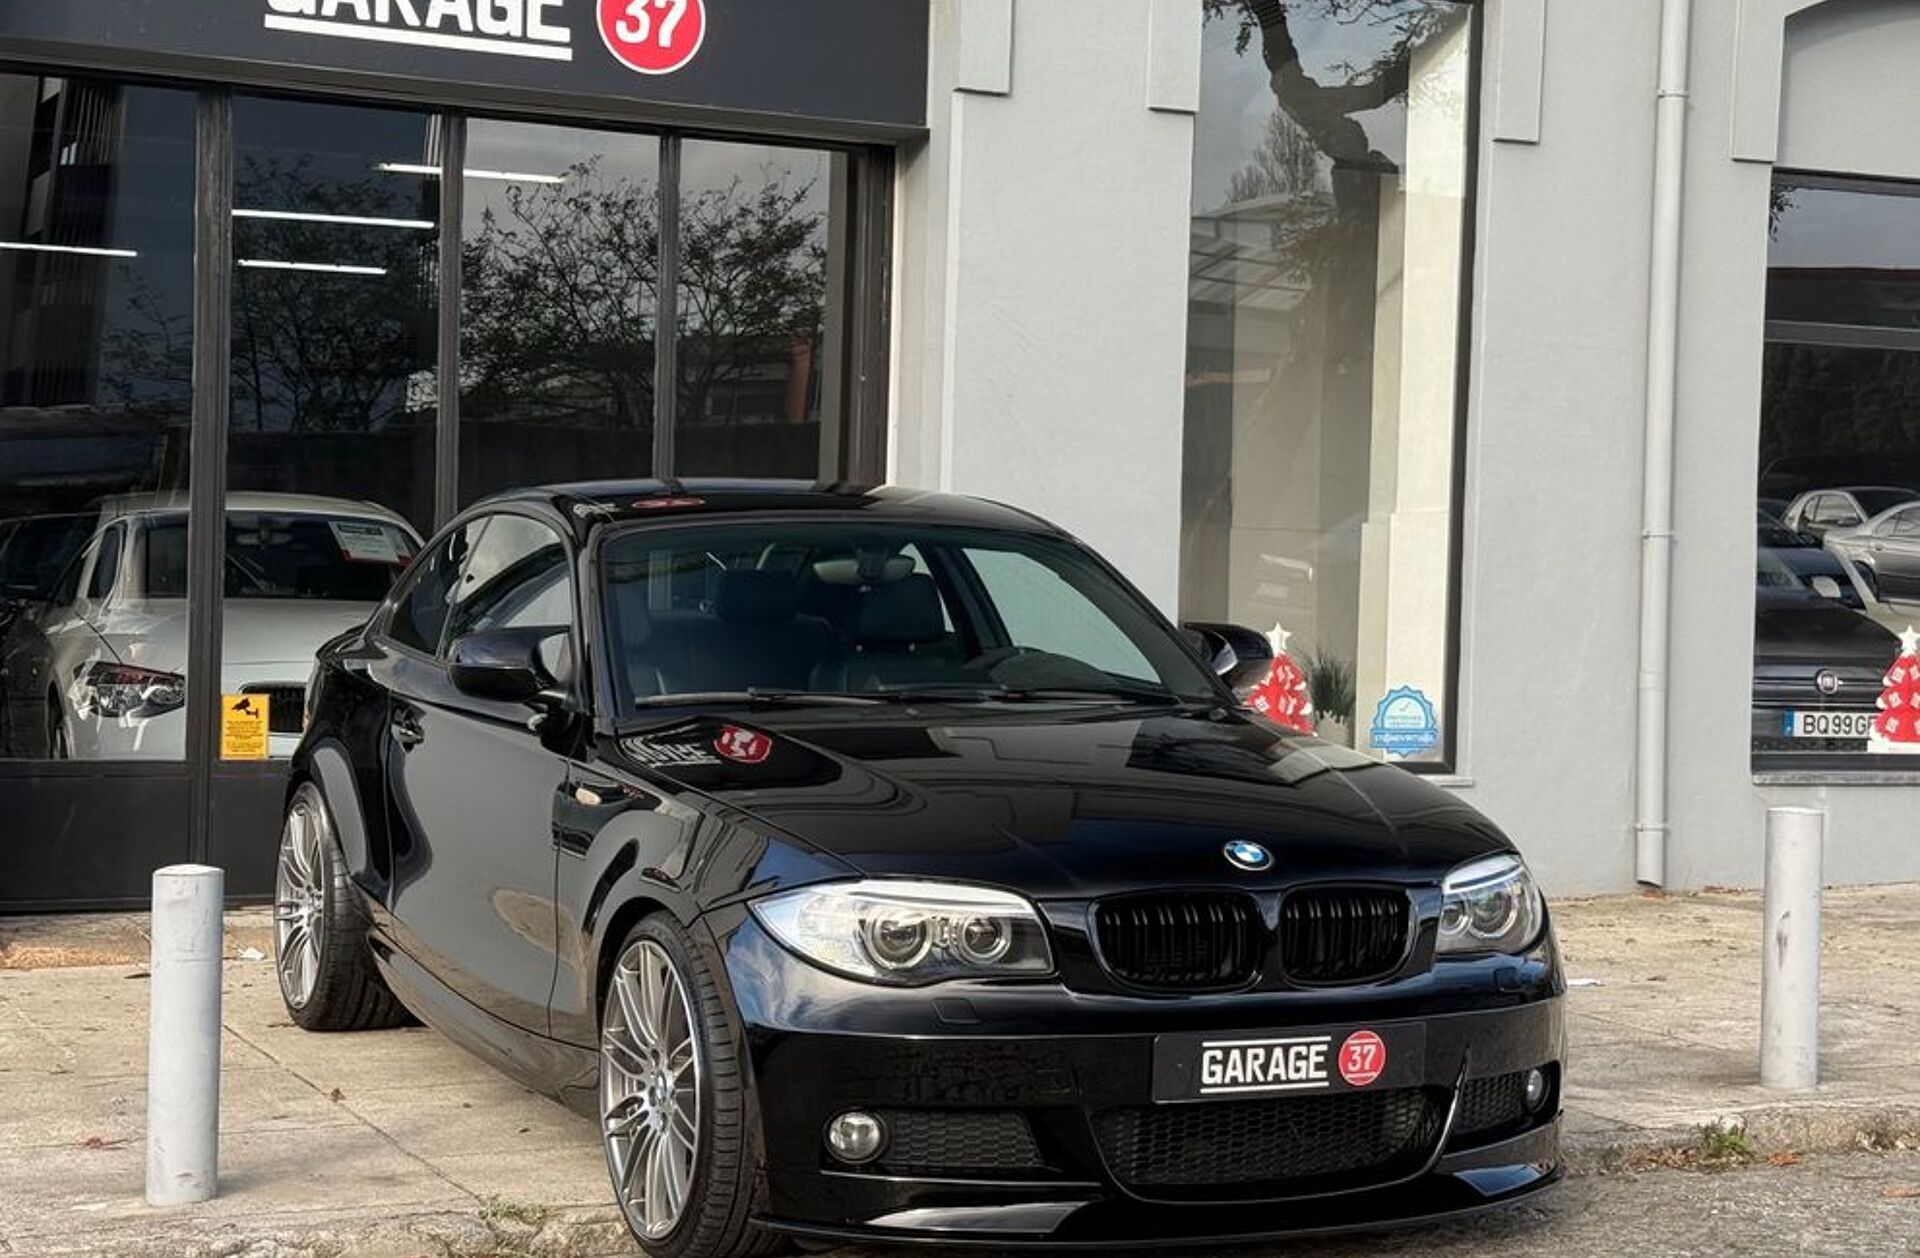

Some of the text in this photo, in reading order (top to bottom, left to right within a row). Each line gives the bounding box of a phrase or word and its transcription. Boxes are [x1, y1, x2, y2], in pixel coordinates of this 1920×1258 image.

[615, 0, 687, 48] 37
[1202, 1044, 1376, 1084] GARAGE 37
